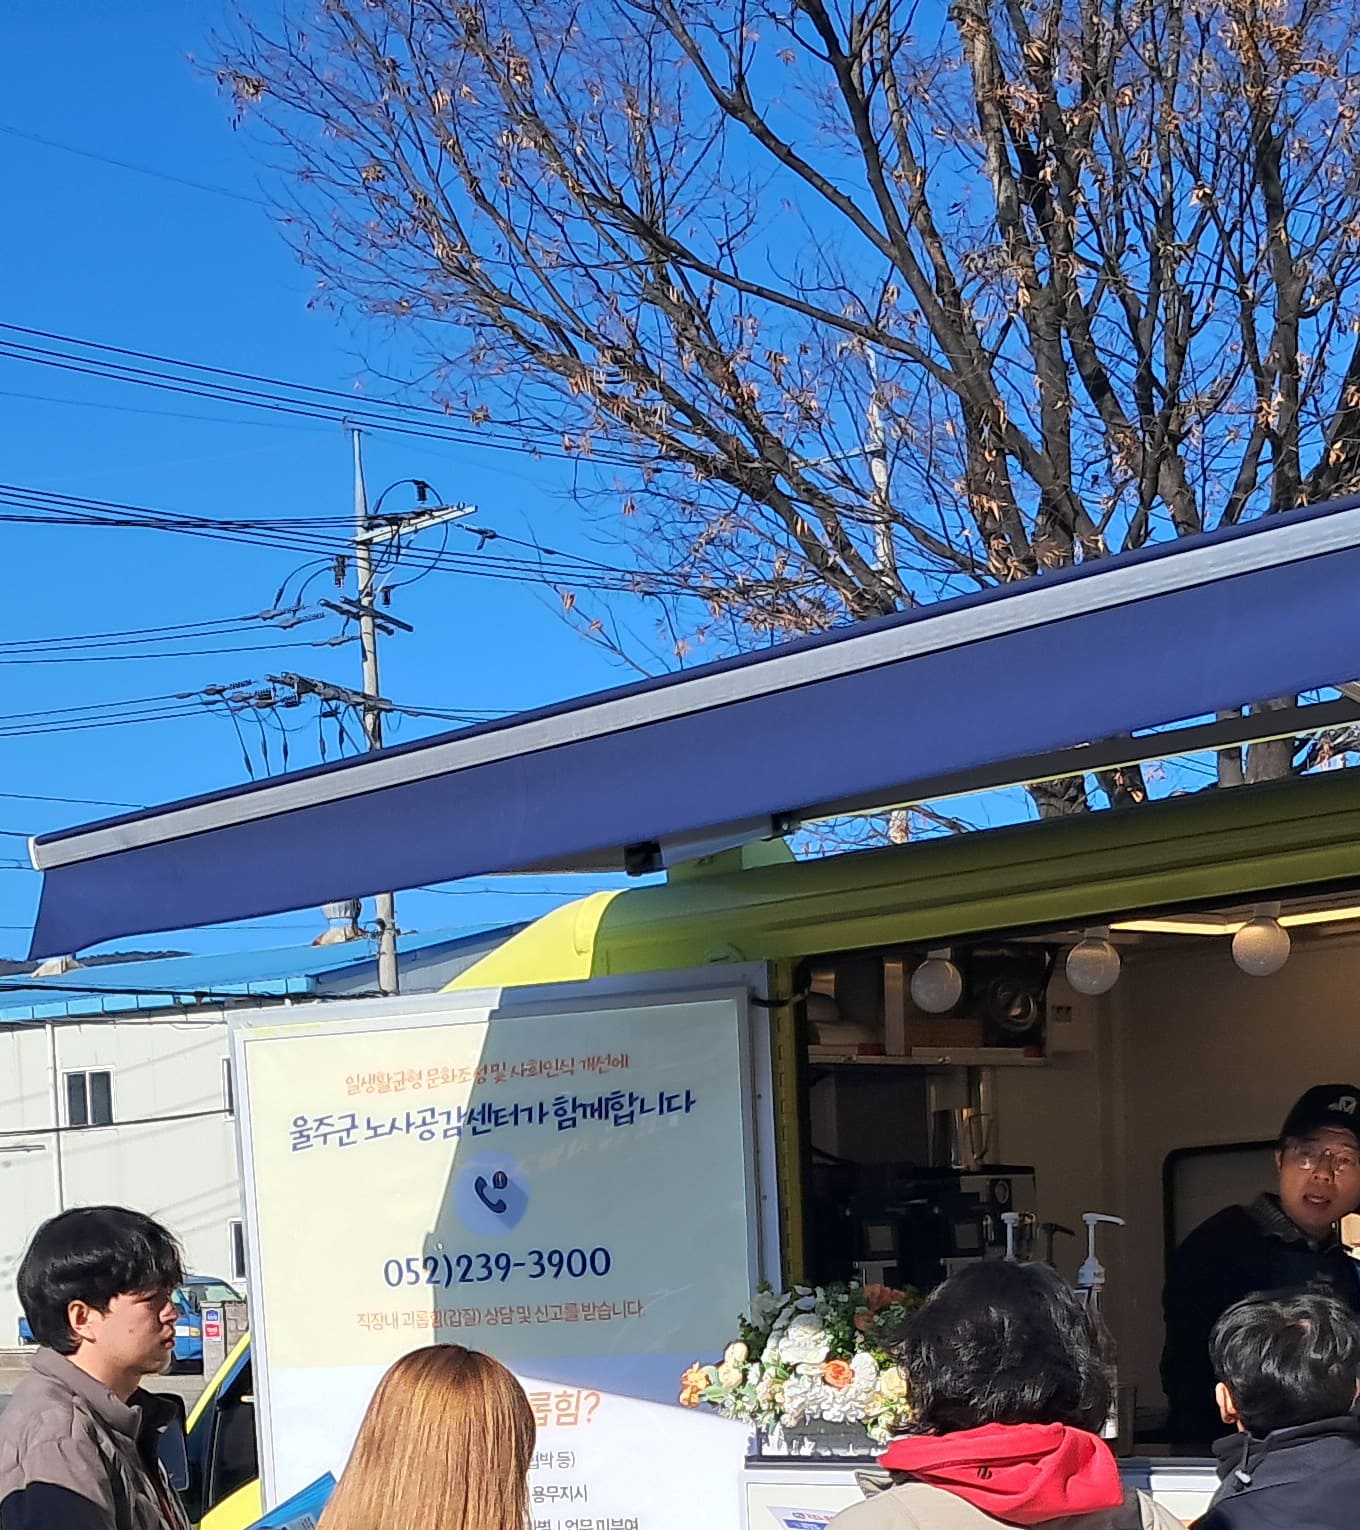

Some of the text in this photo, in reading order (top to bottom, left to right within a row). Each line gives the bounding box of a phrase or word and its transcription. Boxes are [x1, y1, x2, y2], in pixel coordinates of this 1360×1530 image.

[289, 1089, 697, 1152] 울주군 노사공감센터가 함께합니다
[383, 1247, 612, 1288] 052)239-3900
[356, 1312, 399, 1331] 직장내
[484, 1306, 515, 1327] 상담
[517, 1304, 531, 1325] 및
[536, 1302, 578, 1324] 신고를
[532, 1484, 589, 1504] 용무지시
